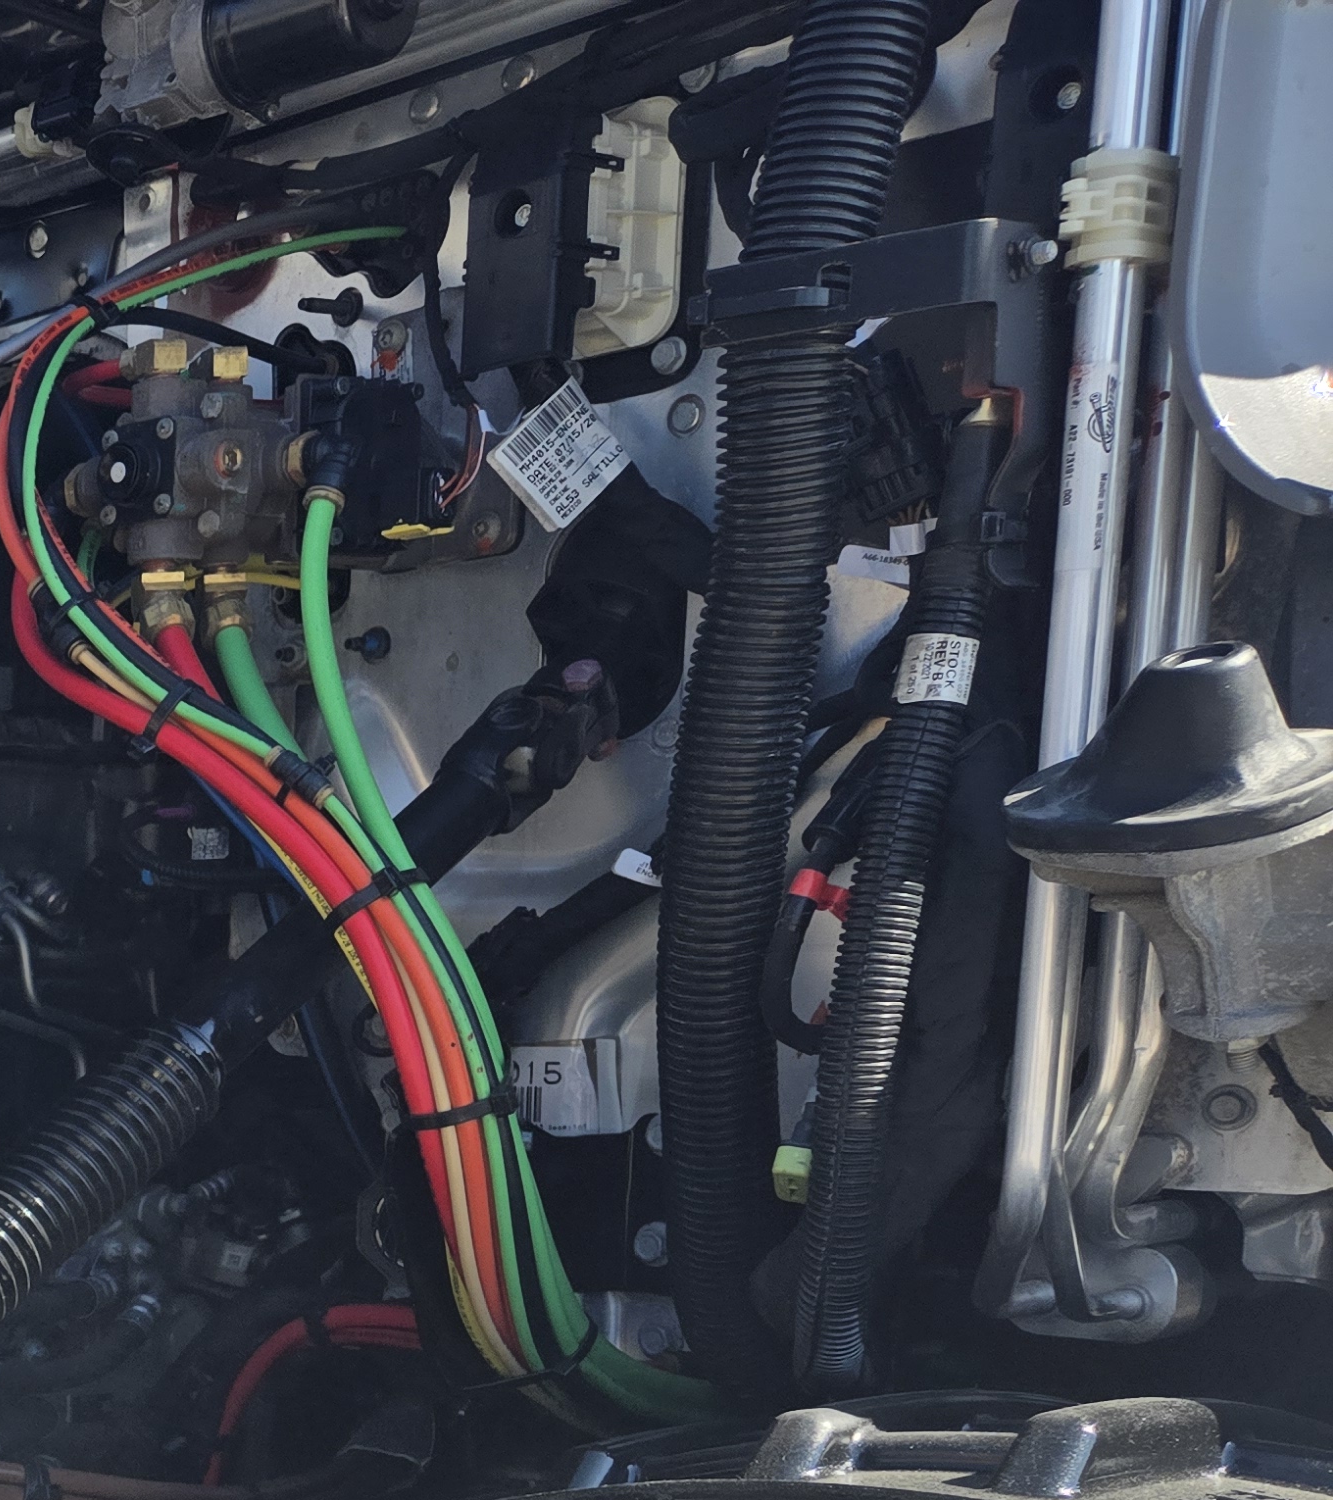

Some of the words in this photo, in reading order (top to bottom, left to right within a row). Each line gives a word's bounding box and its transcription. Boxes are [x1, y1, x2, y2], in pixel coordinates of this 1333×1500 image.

[555, 489, 580, 515] AL53
[582, 444, 624, 488] SALTILLO
[935, 640, 949, 668] REV
[944, 640, 961, 689] STOCK
[932, 672, 944, 681] B
